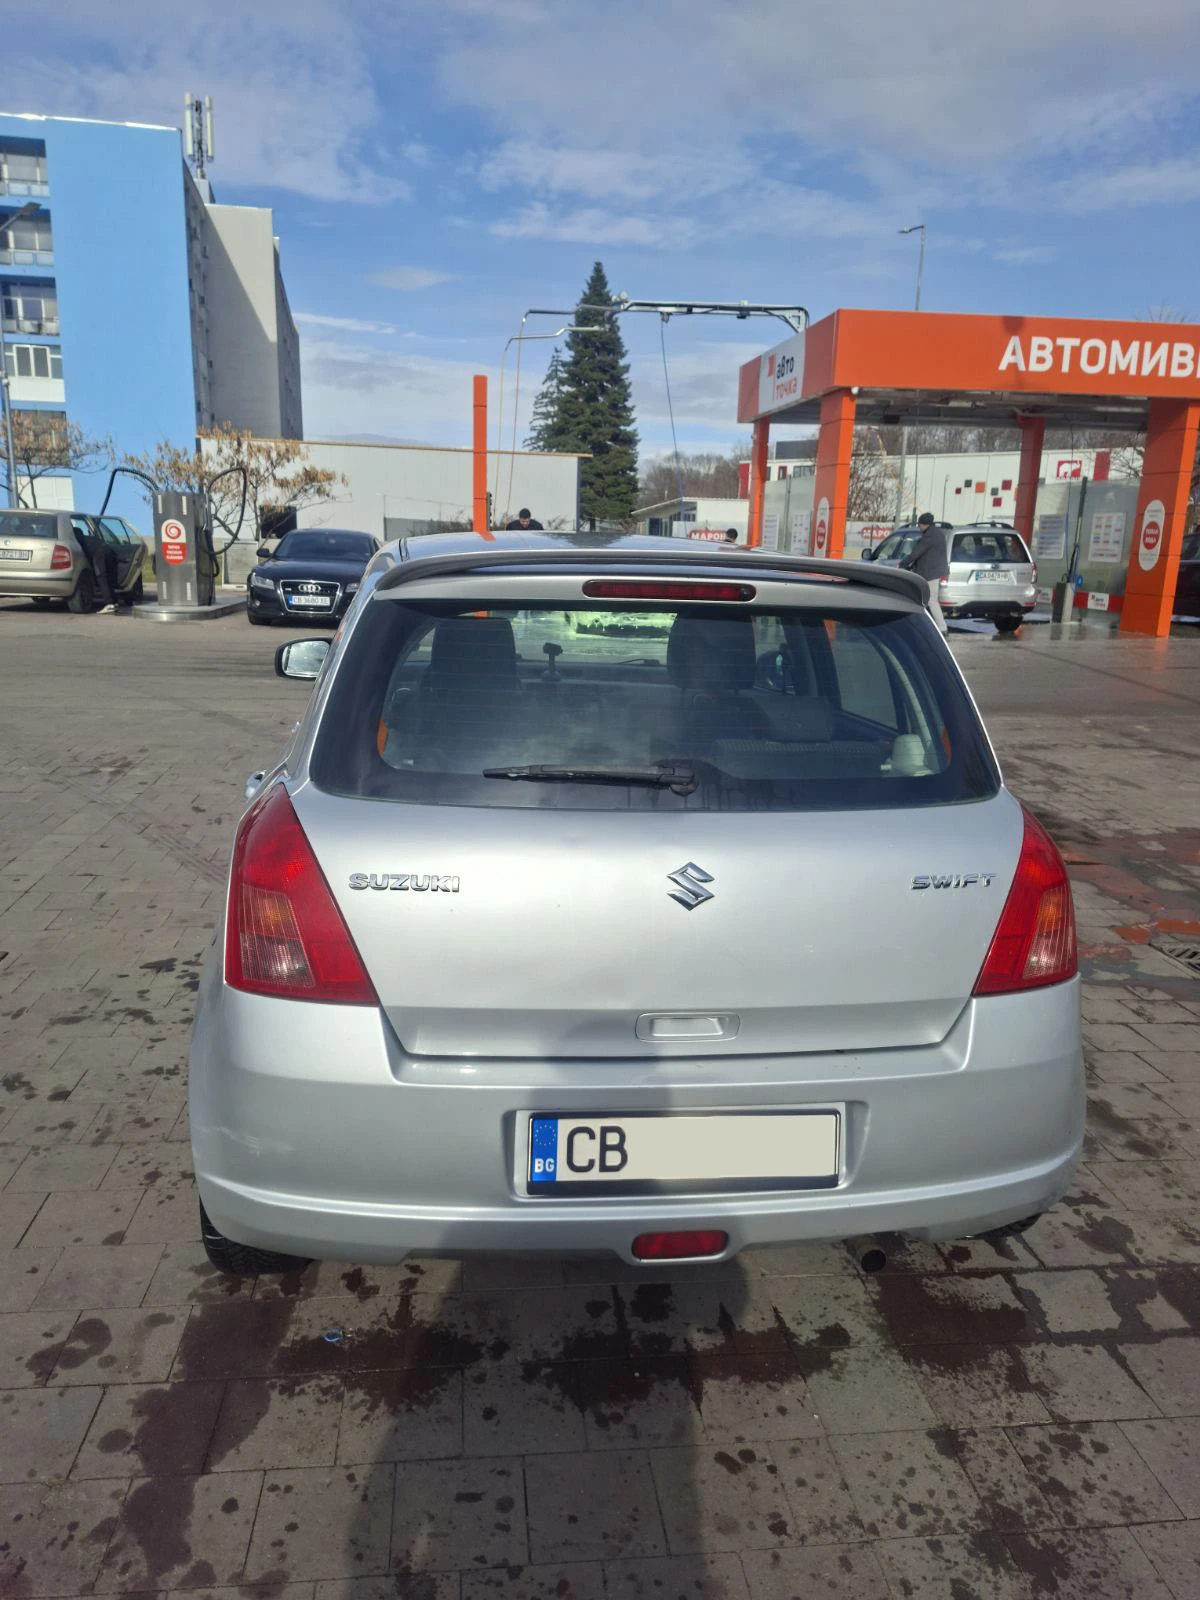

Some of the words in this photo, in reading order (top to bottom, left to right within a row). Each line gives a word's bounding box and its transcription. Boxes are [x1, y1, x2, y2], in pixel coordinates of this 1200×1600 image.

[998, 335, 1200, 378] АВТОМИВ
[349, 873, 460, 892] SUZUKI
[911, 872, 996, 890] SWIFT
[566, 1125, 628, 1173] CB
[533, 1158, 555, 1173] BG
